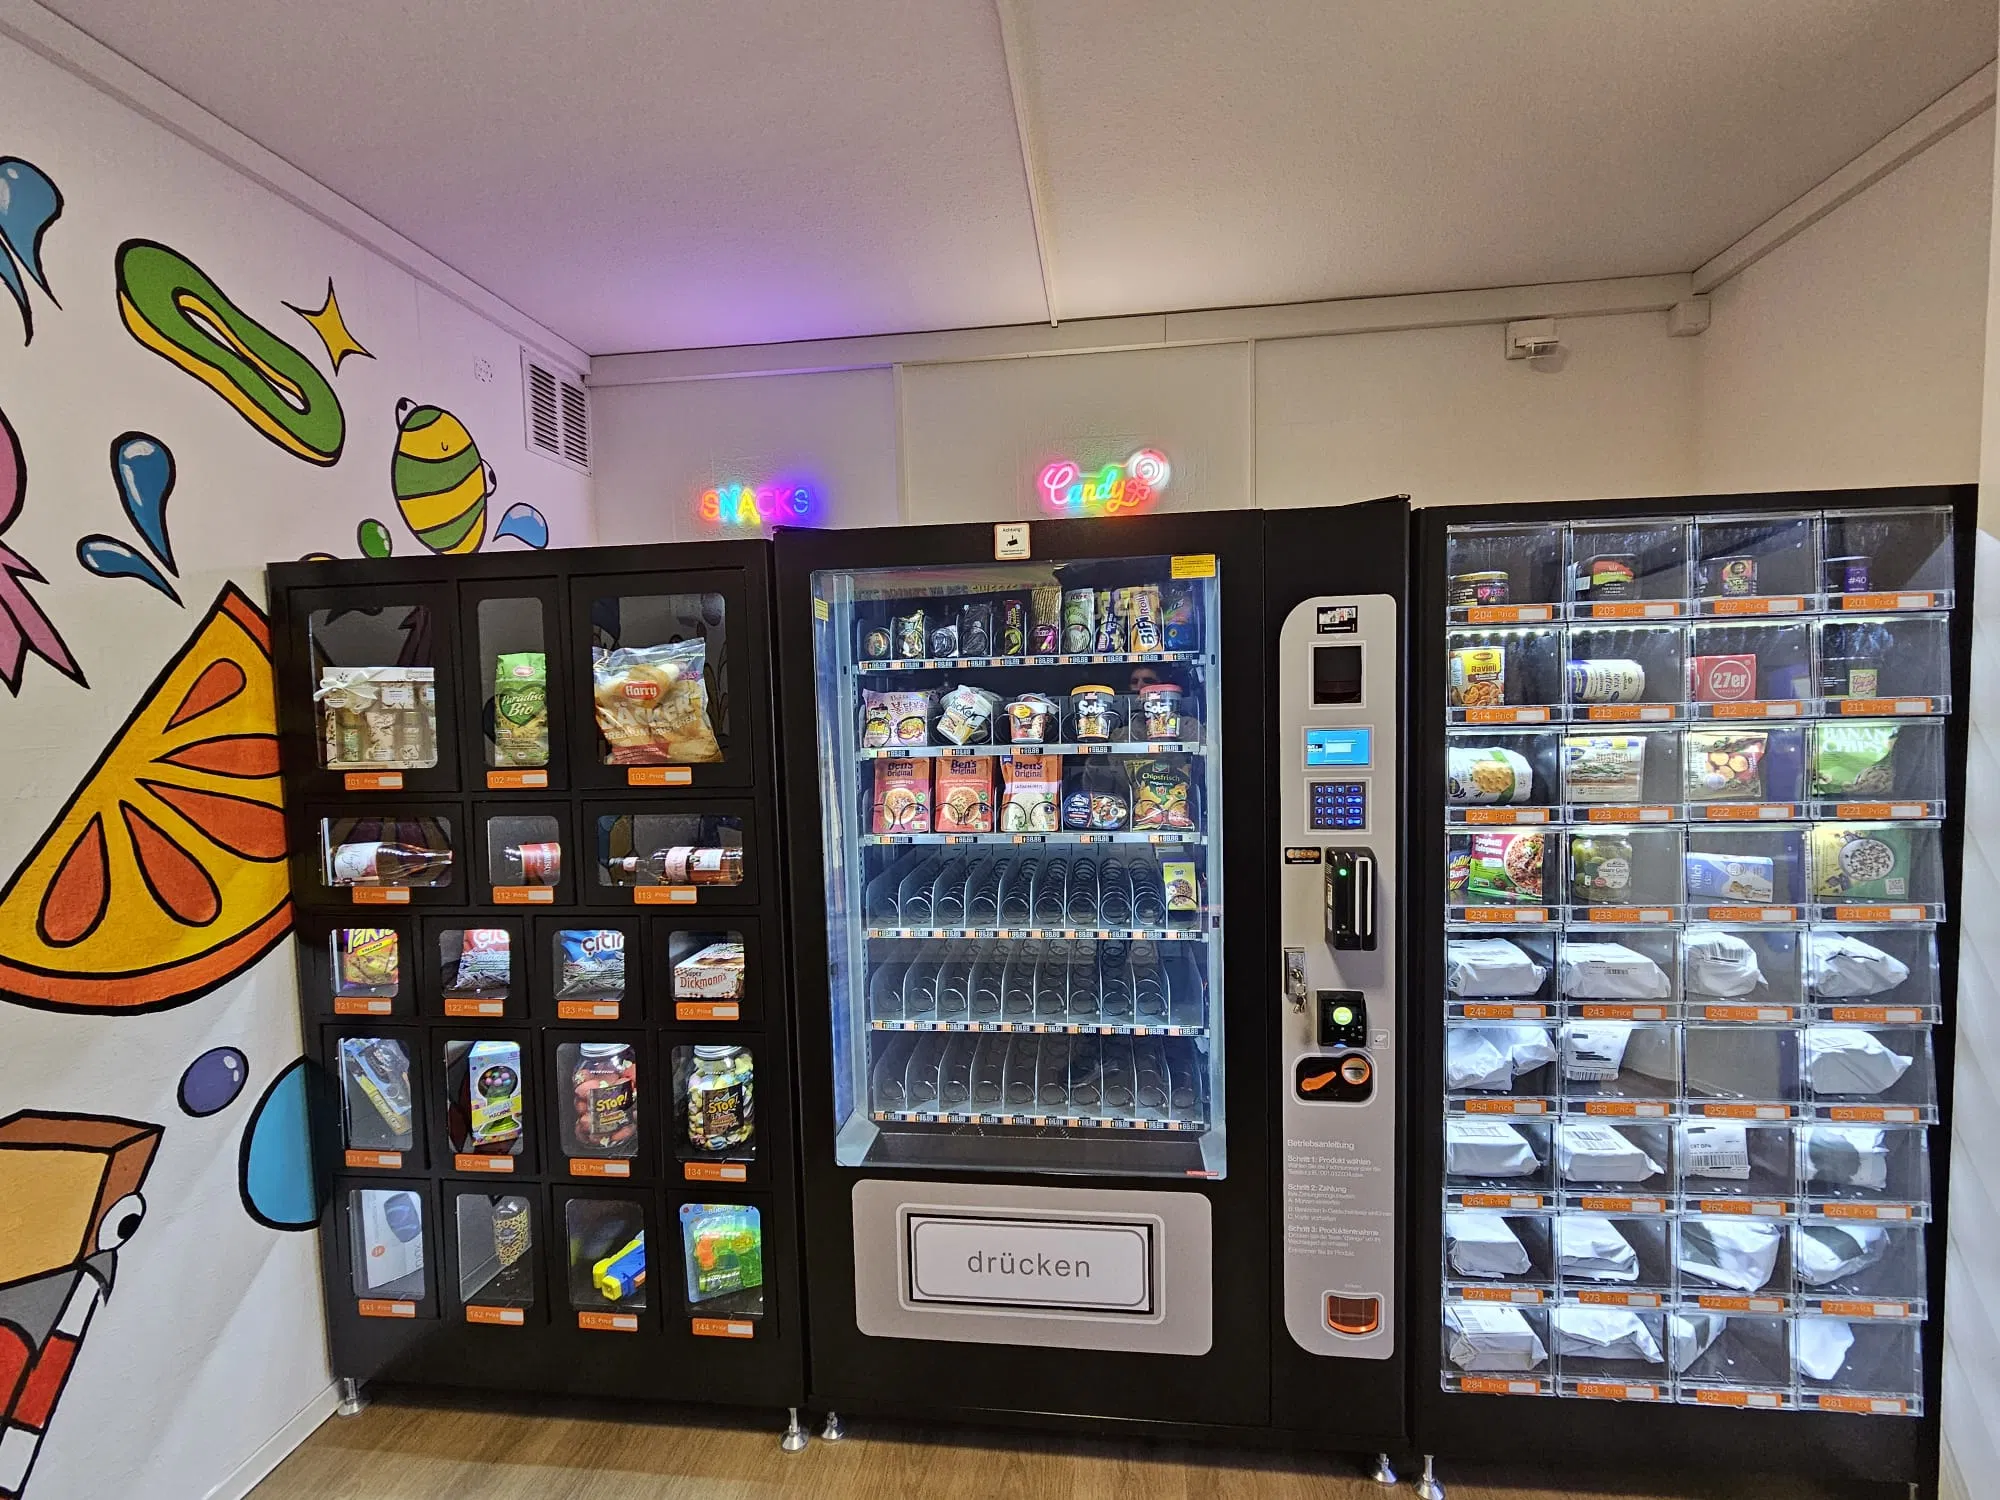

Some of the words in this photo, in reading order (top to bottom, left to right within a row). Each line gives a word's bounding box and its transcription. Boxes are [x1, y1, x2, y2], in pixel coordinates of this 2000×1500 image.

[1043, 465, 1140, 513] Candy
[701, 485, 809, 522] SNACKS
[1848, 576, 1866, 584] #40
[1720, 602, 1737, 610] 202
[1850, 598, 1866, 607] 201
[1474, 611, 1492, 620] 204
[1598, 607, 1615, 616] 203
[1472, 664, 1496, 672] Ravioli
[1713, 672, 1746, 688] 27er
[626, 685, 657, 697] Harry
[502, 692, 545, 706] Paradiso
[508, 703, 534, 717] Bio
[1078, 700, 1107, 715] Soba
[1144, 702, 1172, 715] Soba
[1719, 706, 1736, 715] 212
[1848, 703, 1864, 712] 211
[1472, 712, 1490, 720] 214
[1595, 710, 1611, 718] 213
[888, 762, 913, 770] Ben's
[951, 759, 977, 768] Ben's
[1015, 762, 1042, 770] Ben's
[951, 768, 976, 776] Original
[1015, 770, 1042, 778] Original
[1142, 773, 1180, 781] Chipsfrisch
[1712, 808, 1729, 816] 222
[1844, 806, 1860, 815] 221
[1472, 812, 1488, 820] 224
[1595, 811, 1611, 820] 223
[1689, 864, 1702, 888] Milch
[1471, 910, 1488, 919] 234
[1595, 911, 1612, 920] 233
[1714, 910, 1732, 918] 232
[1844, 910, 1860, 918] 231
[680, 972, 726, 989] Dickmann's
[1470, 1008, 1486, 1016] 244
[1711, 1008, 1728, 1017] 242
[1840, 1010, 1856, 1019] 241
[596, 1092, 628, 1112] STOP!
[708, 1094, 740, 1114] STOP!
[1472, 1103, 1487, 1112] 254
[1591, 1104, 1607, 1113] 253
[1710, 1106, 1727, 1115] 252
[489, 1108, 511, 1118] MACHINE
[1838, 1110, 1854, 1119] 251
[1288, 1140, 1354, 1150] Betriebsanleitung
[1318, 1185, 1347, 1193] Zahlung
[1468, 1198, 1484, 1206] 264
[1706, 1203, 1723, 1212] 262
[1830, 1207, 1847, 1215] 261
[967, 1251, 1091, 1278] drücken
[1469, 1290, 1484, 1298] 274
[1584, 1294, 1600, 1302] 273
[1828, 1304, 1844, 1312] 271
[1467, 1380, 1482, 1388] 284
[1582, 1385, 1598, 1394] 283
[1702, 1392, 1719, 1400] 282
[1826, 1398, 1842, 1407] 281
